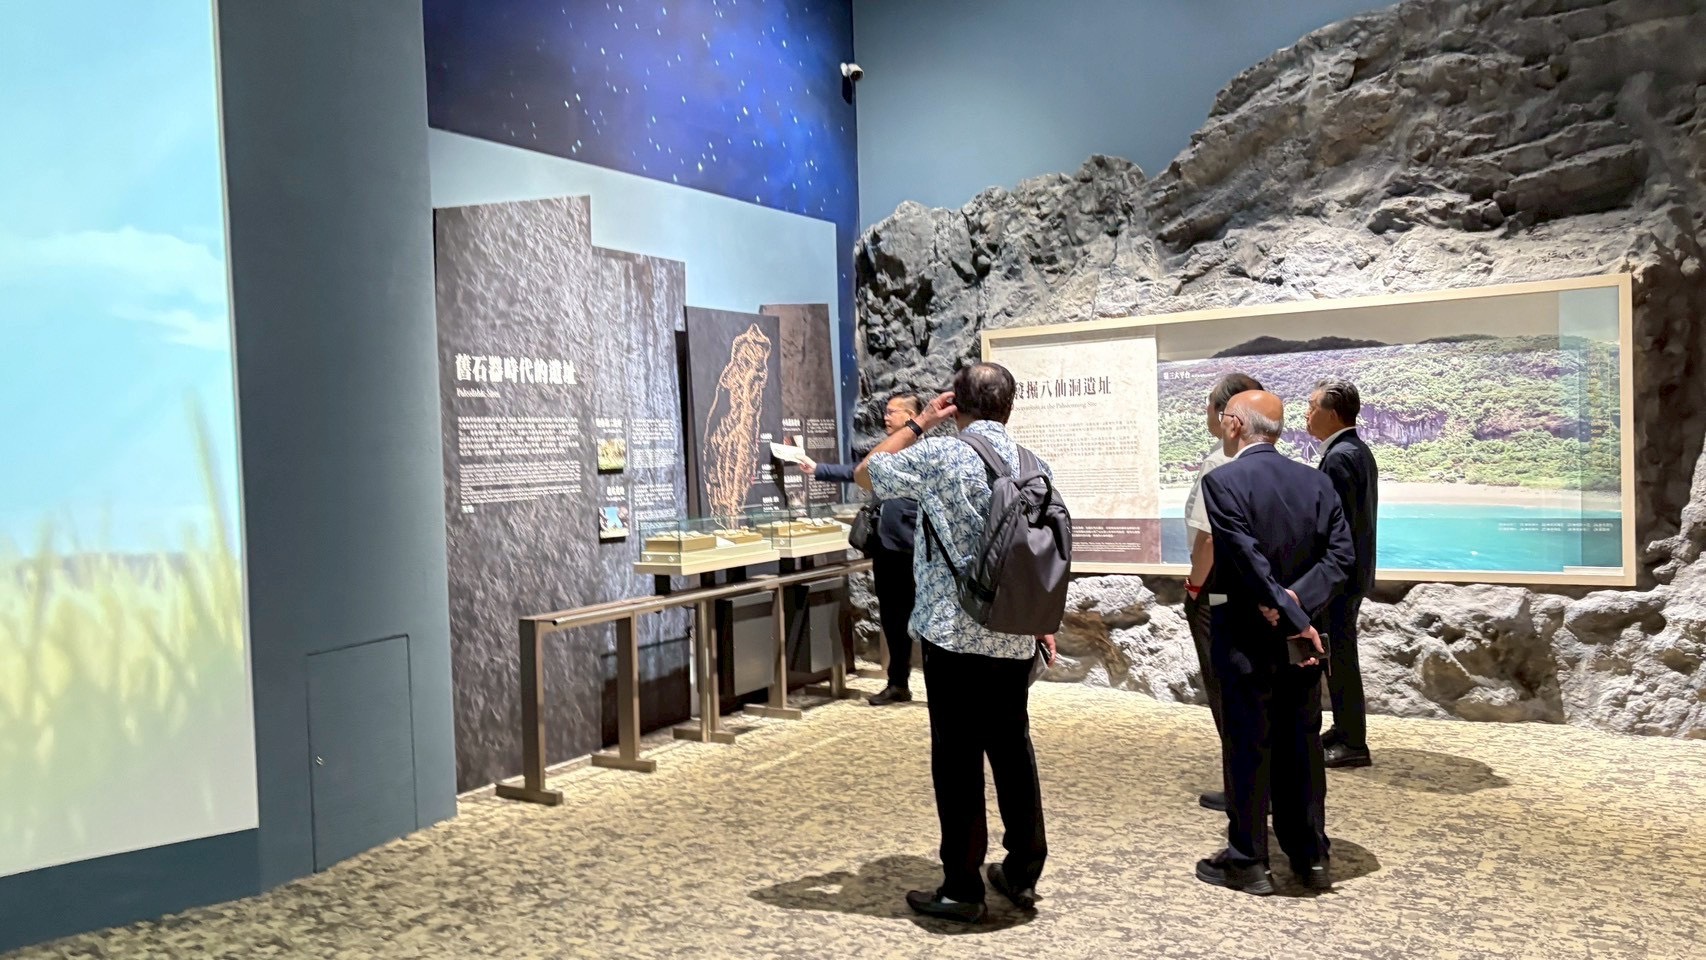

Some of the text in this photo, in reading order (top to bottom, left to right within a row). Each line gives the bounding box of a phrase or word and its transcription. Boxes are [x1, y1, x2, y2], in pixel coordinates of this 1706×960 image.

[455, 353, 577, 384] 舊石器時代的遺址
